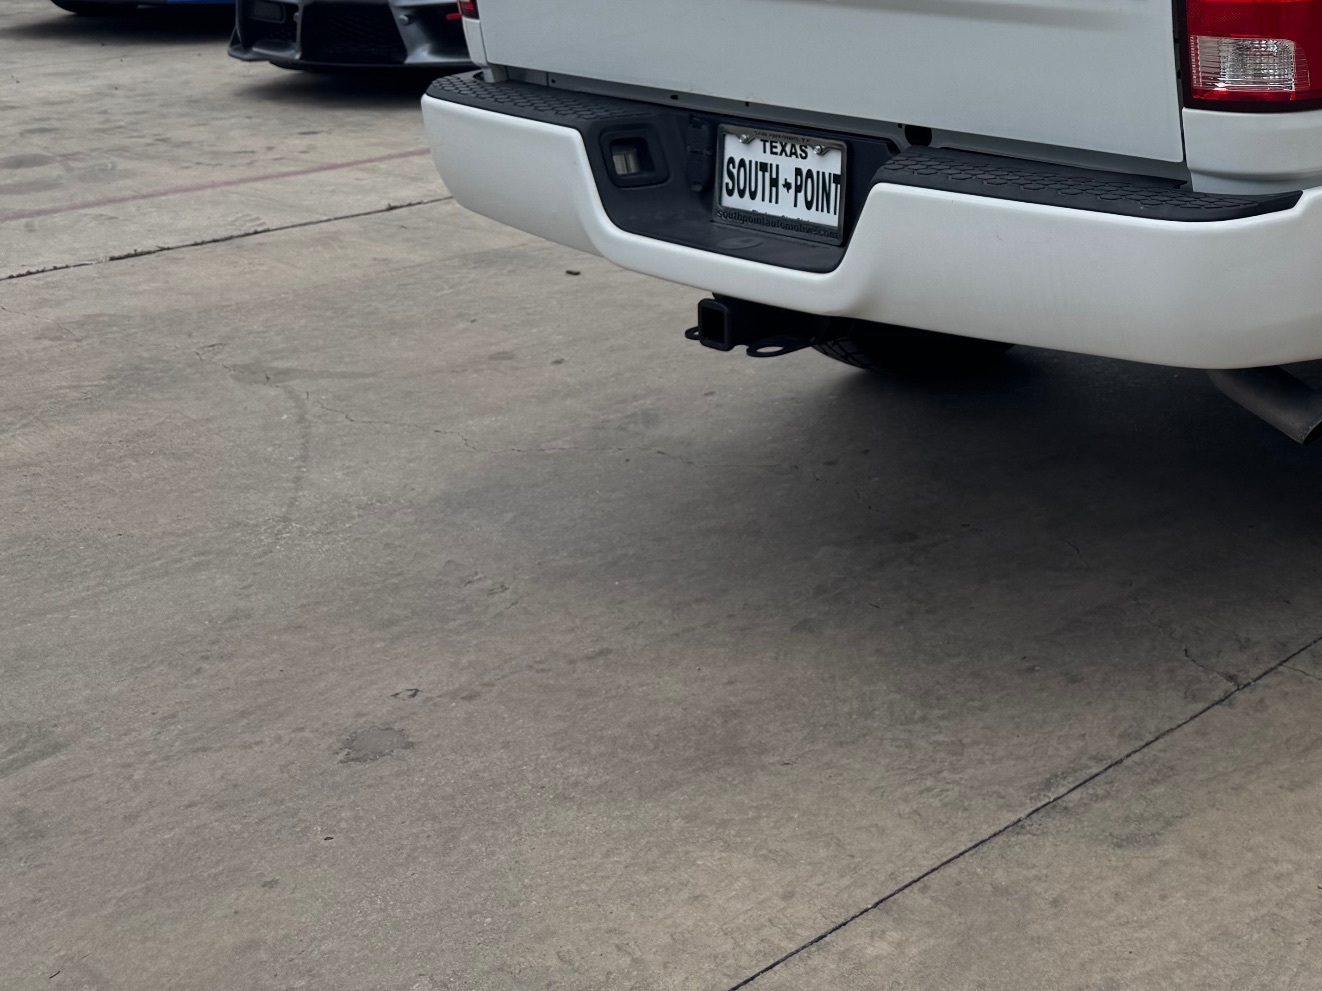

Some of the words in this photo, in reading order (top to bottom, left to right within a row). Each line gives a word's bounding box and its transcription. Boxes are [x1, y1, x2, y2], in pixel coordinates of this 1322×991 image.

[760, 138, 809, 160] TEXAS
[725, 156, 780, 205] SOUTH
[793, 166, 842, 216] POINT
[717, 210, 840, 240] southpointautomotive.com
